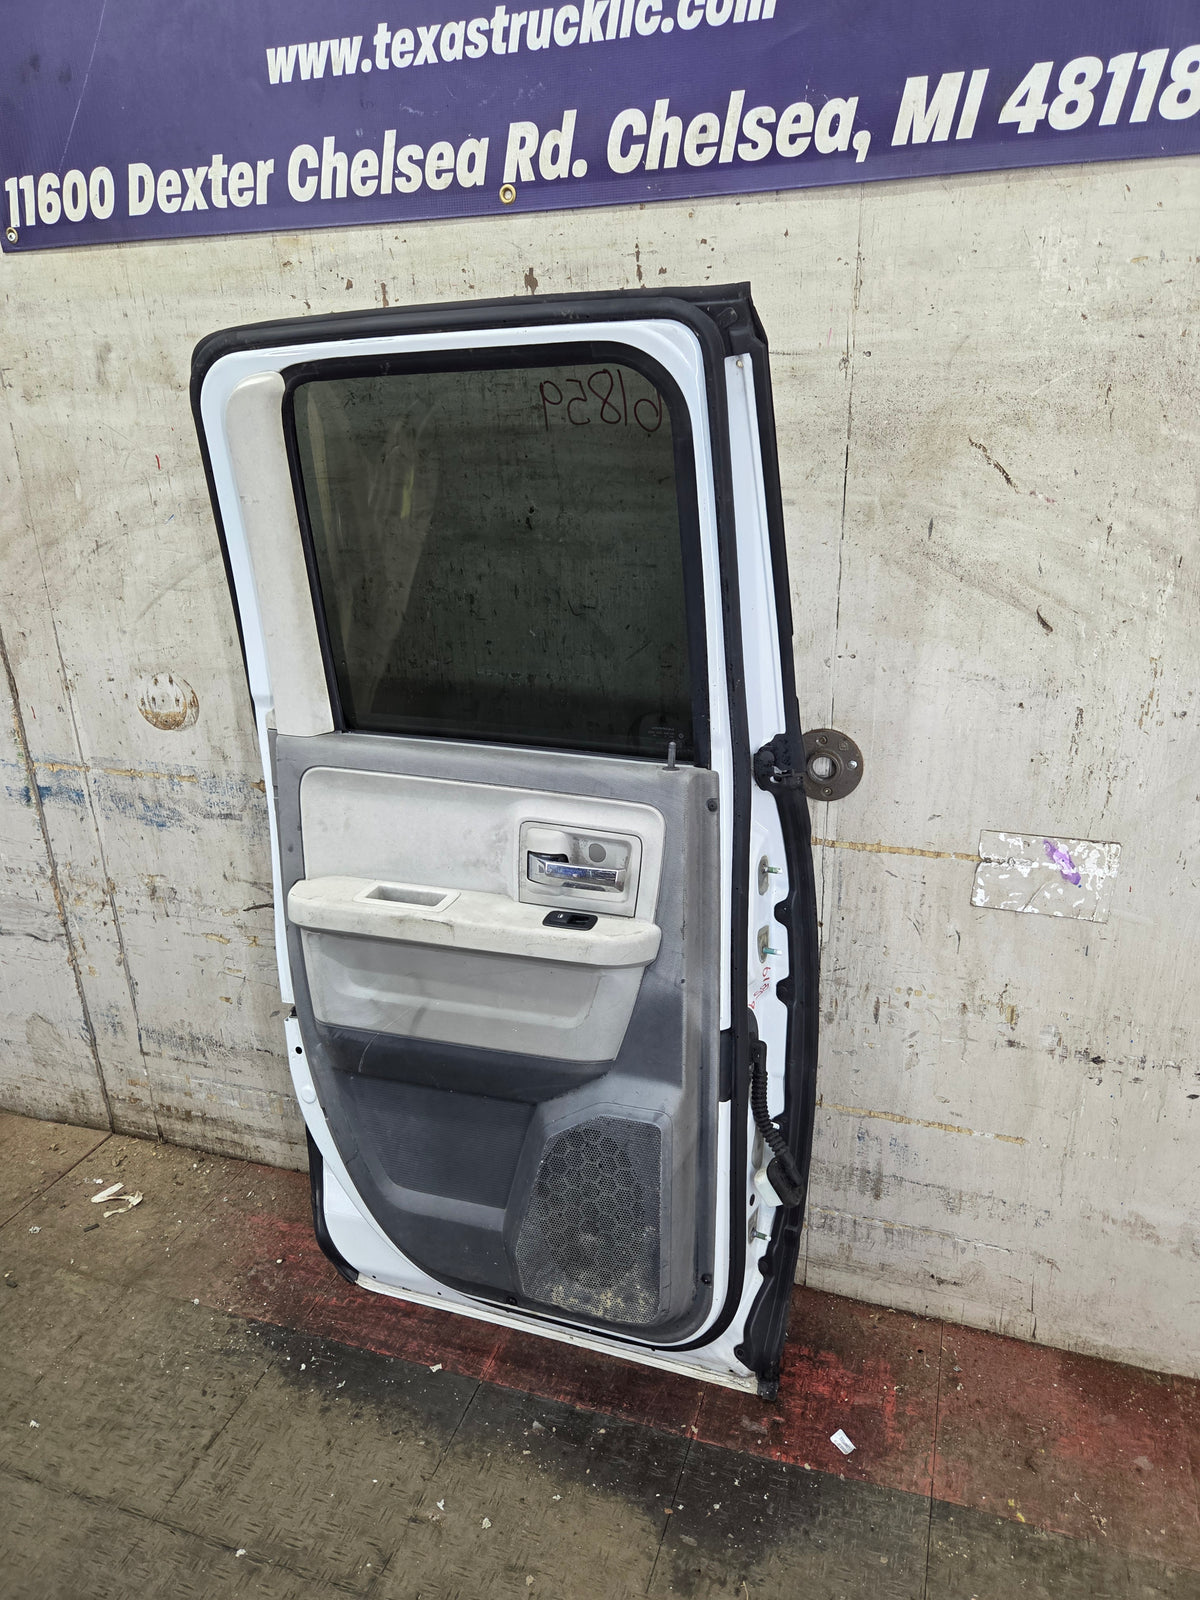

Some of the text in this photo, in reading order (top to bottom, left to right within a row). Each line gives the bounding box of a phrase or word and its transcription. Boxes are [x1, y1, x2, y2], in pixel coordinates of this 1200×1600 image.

[266, 0, 777, 84] www.texastruckllc.com
[4, 44, 1200, 228] 11600 Dexter Chelsea Rd. Chelsea, MI 48118
